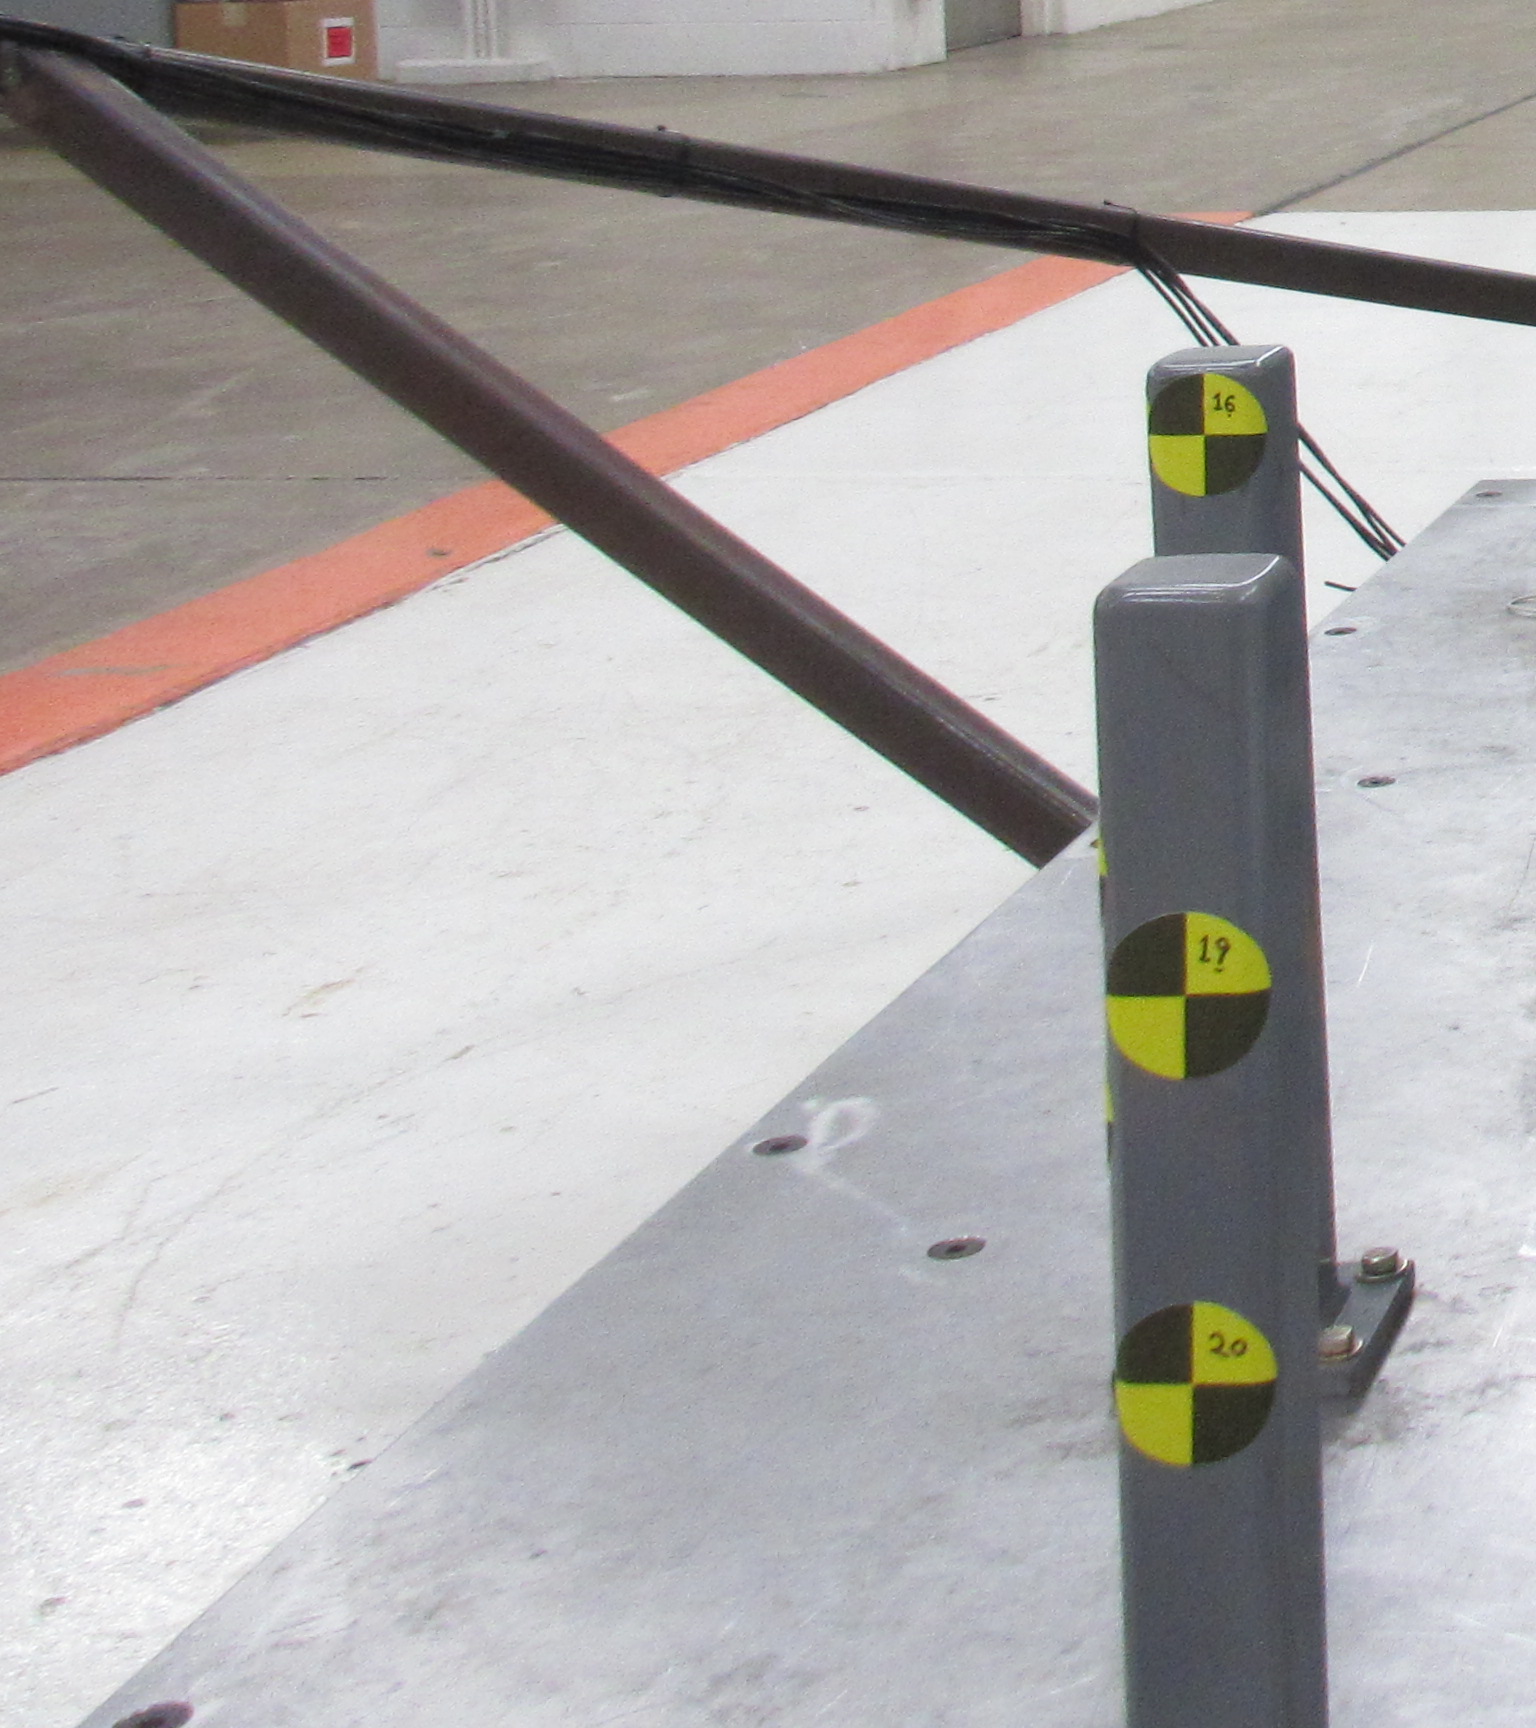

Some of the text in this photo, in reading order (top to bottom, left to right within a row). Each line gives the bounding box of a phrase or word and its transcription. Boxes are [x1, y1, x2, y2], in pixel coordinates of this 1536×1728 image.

[1212, 392, 1237, 413] 16
[1199, 934, 1232, 966] 19
[1208, 1329, 1249, 1358] 20
